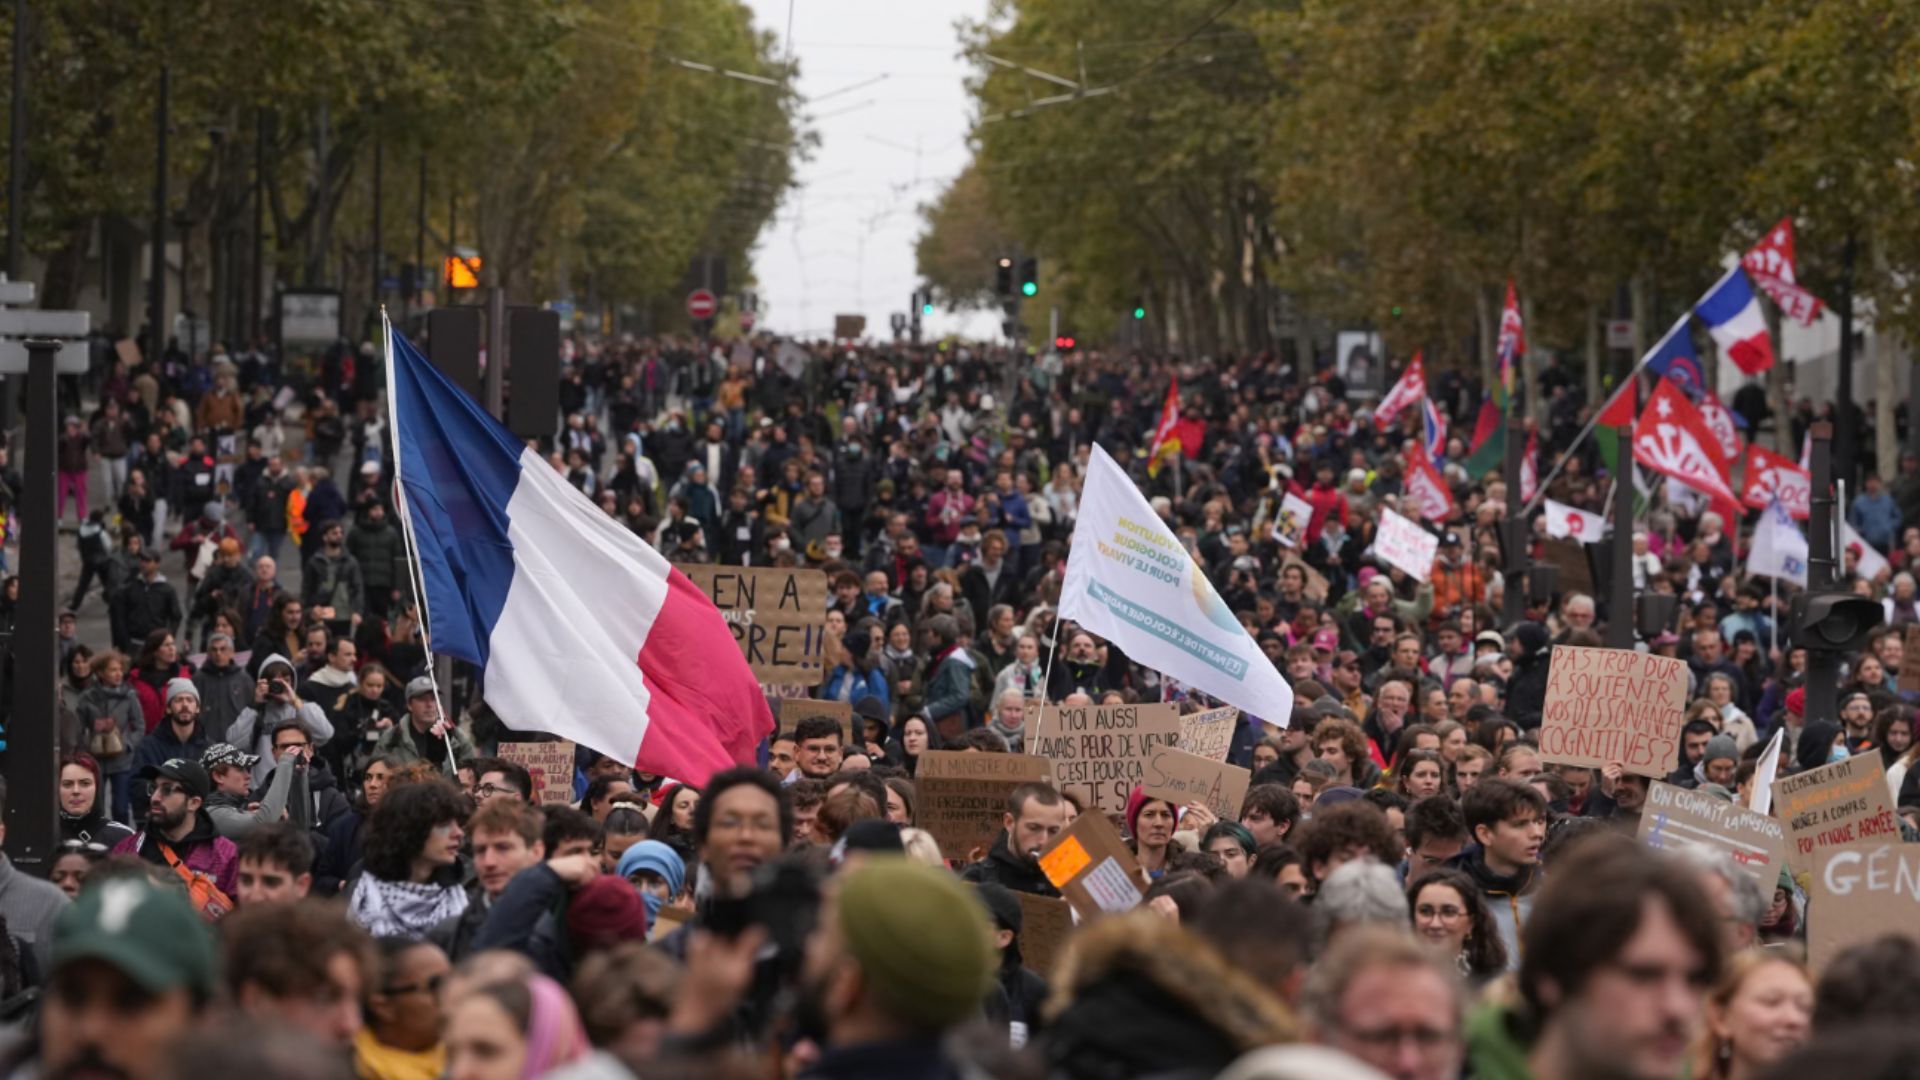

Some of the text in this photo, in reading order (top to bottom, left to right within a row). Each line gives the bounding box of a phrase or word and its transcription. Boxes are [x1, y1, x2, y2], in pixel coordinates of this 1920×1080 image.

[713, 574, 801, 612] EN A
[722, 609, 757, 626] OUS
[1552, 647, 1681, 683] PAS TROP DUR
[1095, 707, 1138, 730] AUSSI
[1544, 696, 1684, 740] VOS DISSONANCES
[1081, 734, 1114, 760] PEUR
[1118, 735, 1136, 758] DE
[1056, 761, 1088, 781] C'EST
[1093, 760, 1125, 781] POUR
[1837, 761, 1853, 778] DIT
[1651, 784, 1672, 806] ON
[1724, 816, 1738, 831] LA
